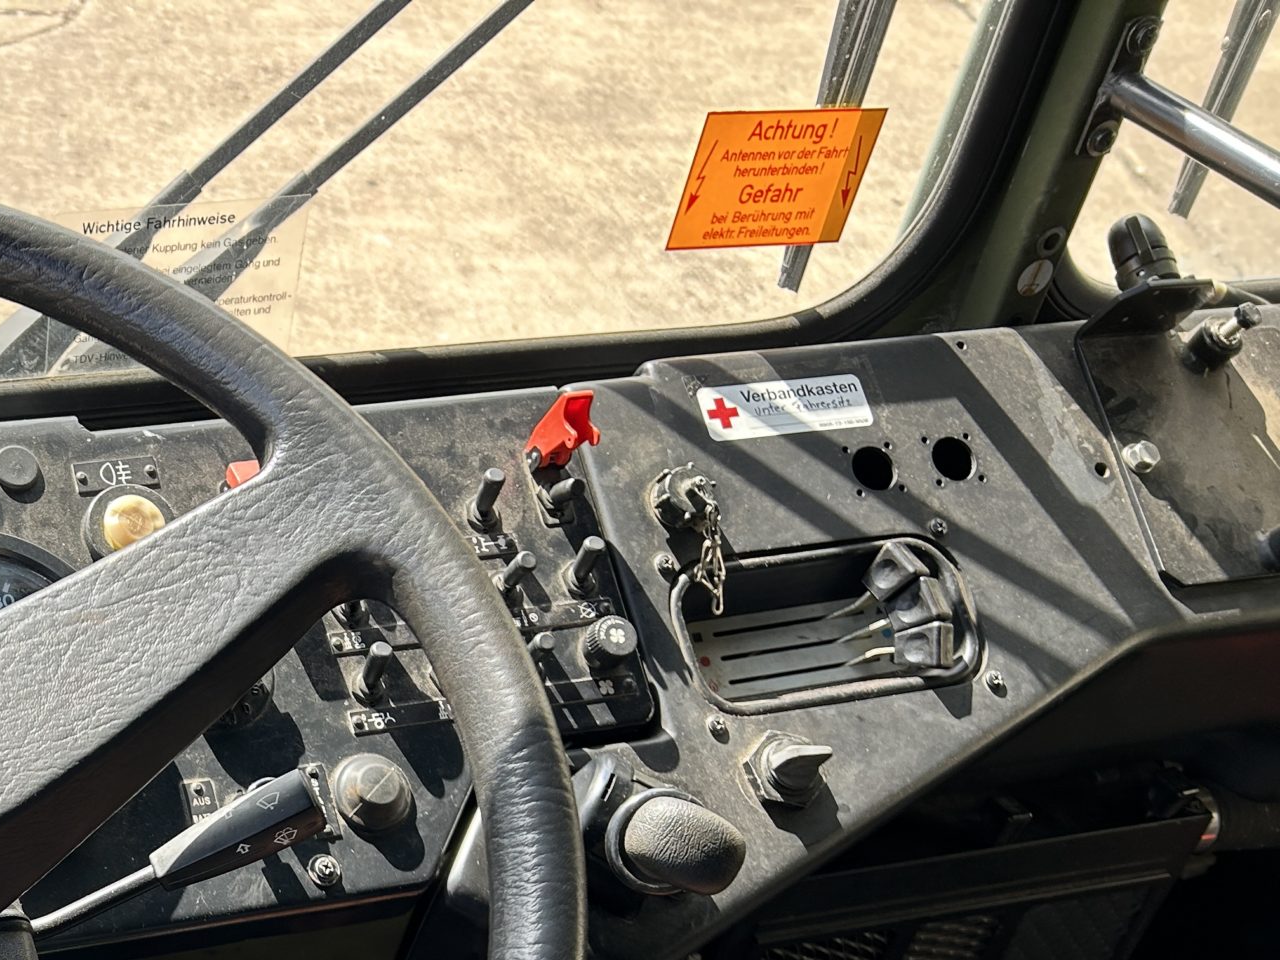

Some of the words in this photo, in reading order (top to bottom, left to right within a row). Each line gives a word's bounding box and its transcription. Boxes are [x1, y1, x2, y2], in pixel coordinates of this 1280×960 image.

[748, 120, 828, 144] Achtung
[829, 118, 839, 138] !
[720, 150, 776, 162] Antennen
[777, 151, 795, 161] vor
[797, 148, 815, 160] der
[816, 146, 849, 159] Fahrt
[733, 163, 825, 178] herunterbinden!
[738, 184, 804, 205] Gefahr
[83, 219, 141, 235] Wichtige
[146, 212, 236, 230] Fahrhinweise
[711, 212, 728, 225] bei
[731, 210, 793, 224] Berührung
[794, 208, 815, 221] mit
[702, 227, 735, 240] elektr.
[736, 225, 811, 240] Freileitungen.
[152, 241, 198, 255] Kupplung
[201, 236, 221, 249] kein
[223, 236, 244, 248] Gas
[172, 263, 231, 277] eingelegtem
[235, 259, 261, 272] Gang
[263, 257, 281, 268] und
[219, 292, 292, 306] peraturkontroll-
[254, 305, 271, 316] und
[739, 380, 858, 404] Verbandkasten
[192, 796, 211, 807] AUS
